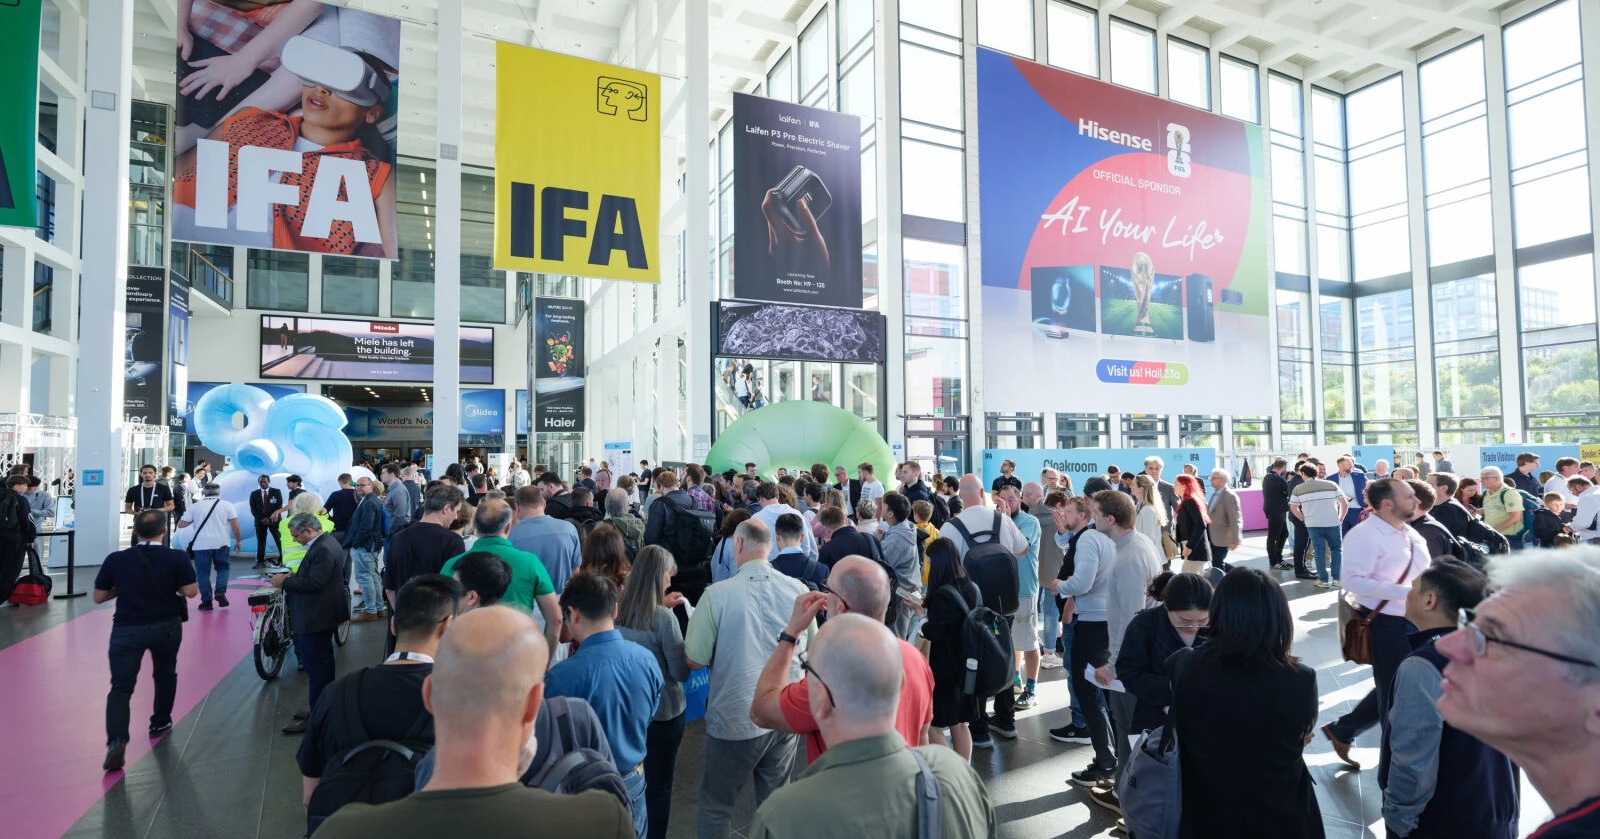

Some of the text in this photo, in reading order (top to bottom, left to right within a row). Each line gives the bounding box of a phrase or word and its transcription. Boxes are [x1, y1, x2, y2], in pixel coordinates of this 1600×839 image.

[808, 120, 820, 129] IFA
[745, 124, 851, 151] Laifen P3 Pro Electric Shaver
[1078, 117, 1153, 152] Hisense
[1174, 164, 1186, 173] FIFA
[1093, 168, 1182, 195] OFFICIAL SPONSOR
[195, 138, 382, 244] IFA
[511, 181, 649, 270] IFA
[1041, 195, 1091, 236] AI
[1099, 208, 1157, 245] Your
[354, 337, 415, 348] Miele has left
[356, 346, 372, 354] the
[374, 346, 412, 358] building.
[1107, 364, 1180, 379] Visit us! Hall 23a
[170, 414, 183, 427] Haier
[377, 417, 412, 425] World's
[544, 417, 576, 427] Haier
[1190, 453, 1200, 462] IFA
[1482, 453, 1497, 462] Trade
[1043, 460, 1098, 473] Cloakroom
